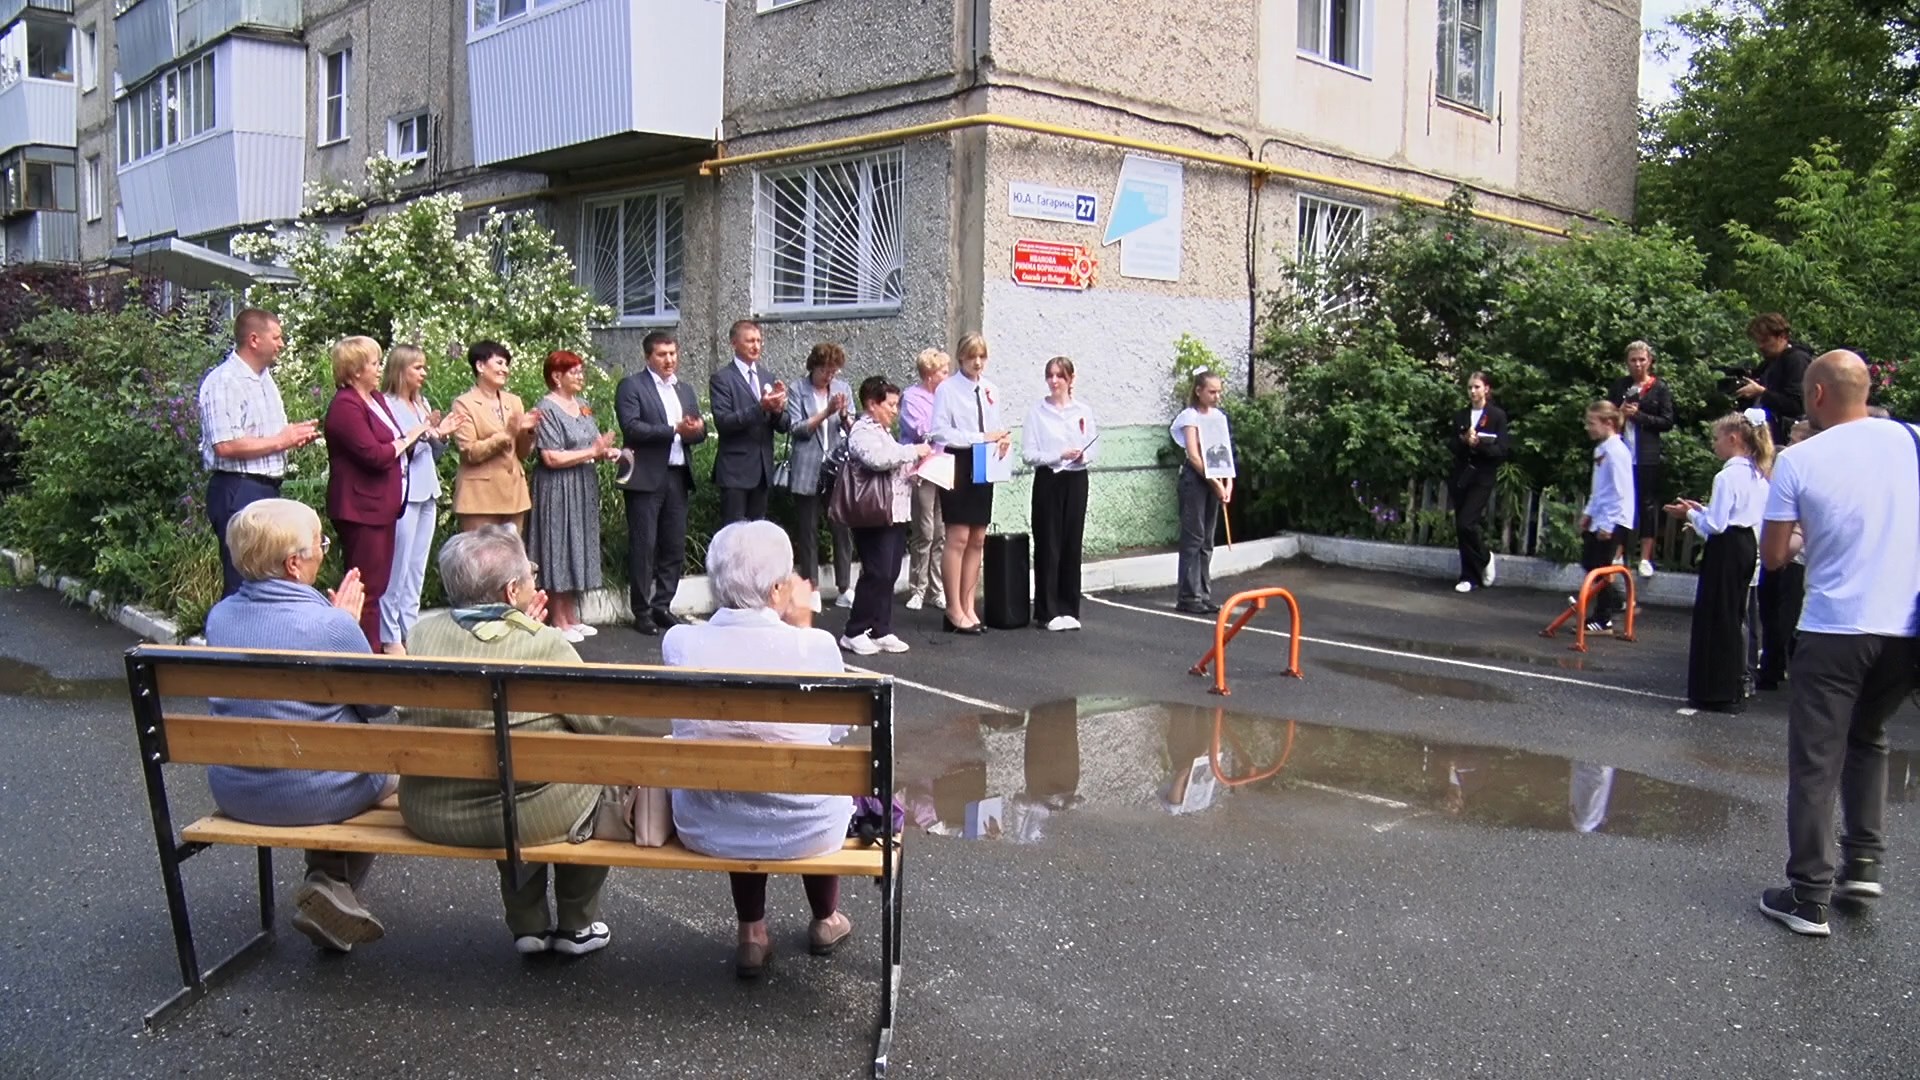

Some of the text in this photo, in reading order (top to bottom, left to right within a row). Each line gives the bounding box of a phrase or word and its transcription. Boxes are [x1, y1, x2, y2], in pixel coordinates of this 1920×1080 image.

[1013, 192, 1034, 204] Ю.А.
[1037, 194, 1074, 209] Гагарина
[1078, 199, 1094, 218] 27
[1029, 254, 1057, 264] ИВАНОВА
